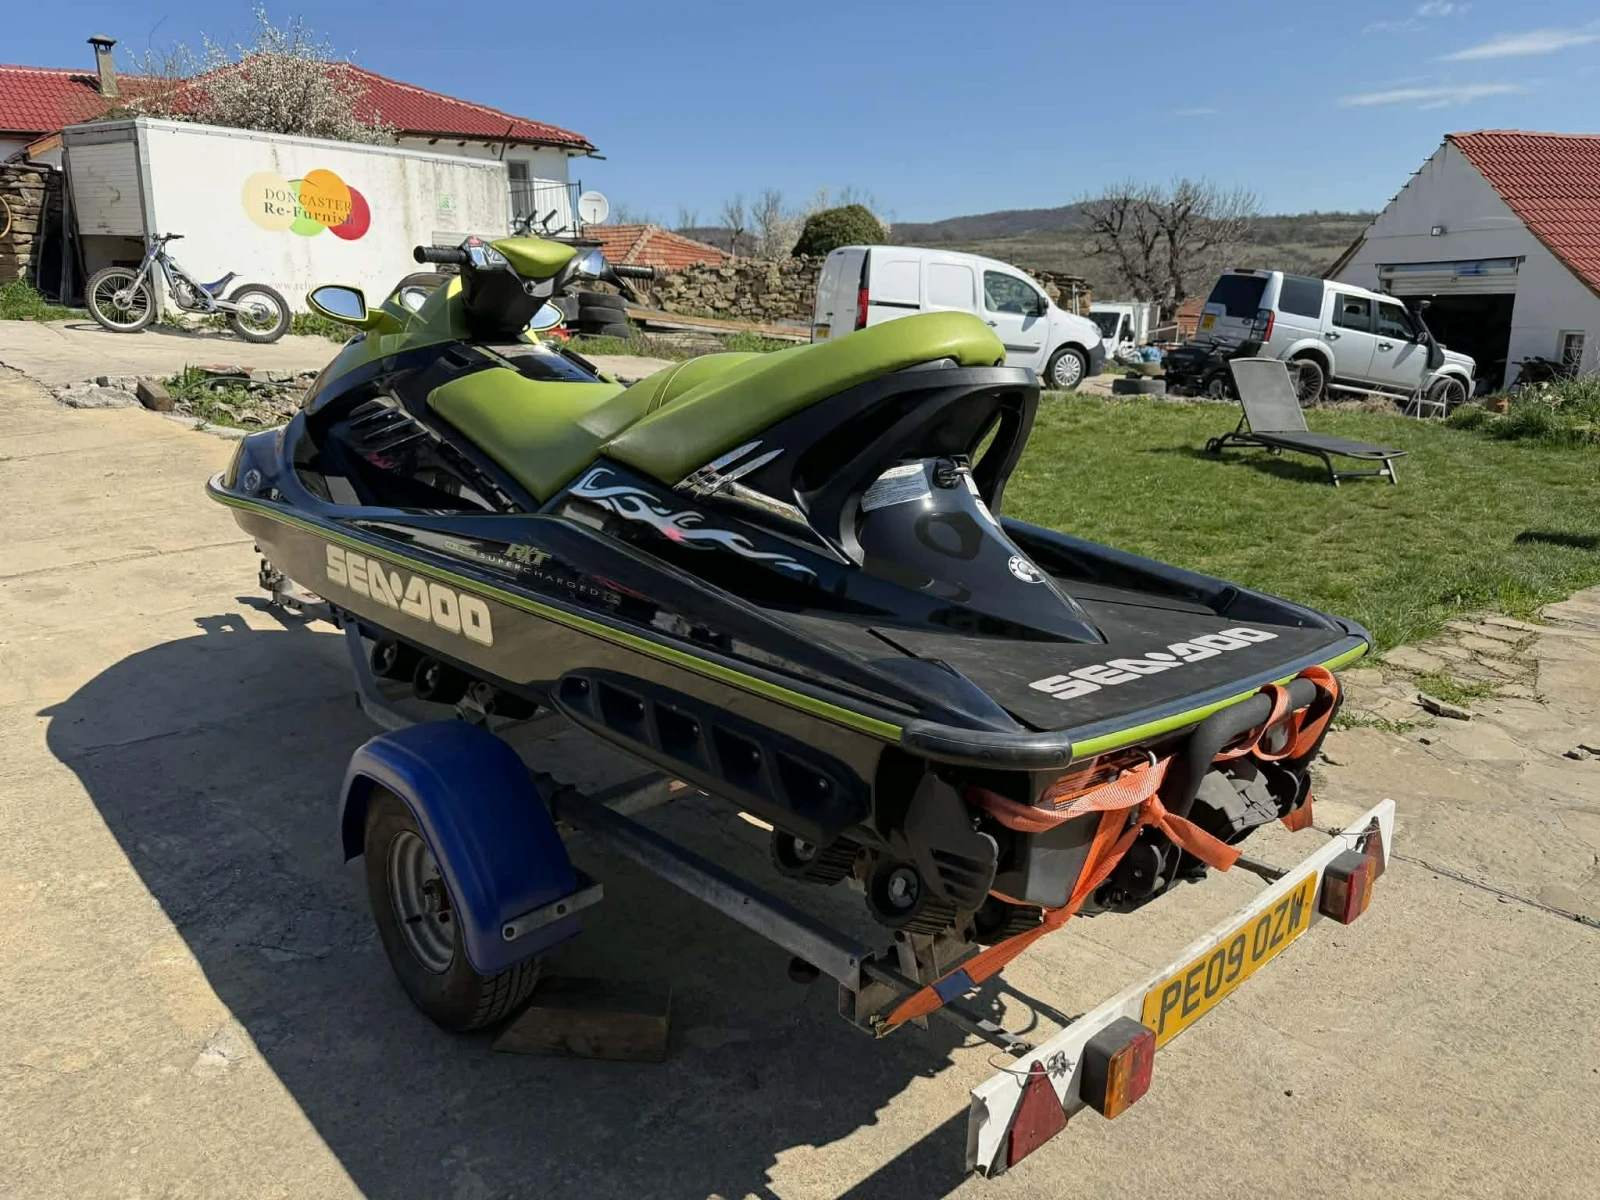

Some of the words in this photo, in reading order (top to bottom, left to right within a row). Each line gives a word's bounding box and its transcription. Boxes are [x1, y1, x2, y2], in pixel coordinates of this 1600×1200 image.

[264, 188, 352, 212] DONCASTER
[264, 202, 354, 225] Re-Furnish
[504, 543, 552, 566] RXT
[478, 553, 599, 596] SUPERCHARGED
[1157, 932, 1247, 1037] PE09
[1252, 884, 1307, 963] OZW
